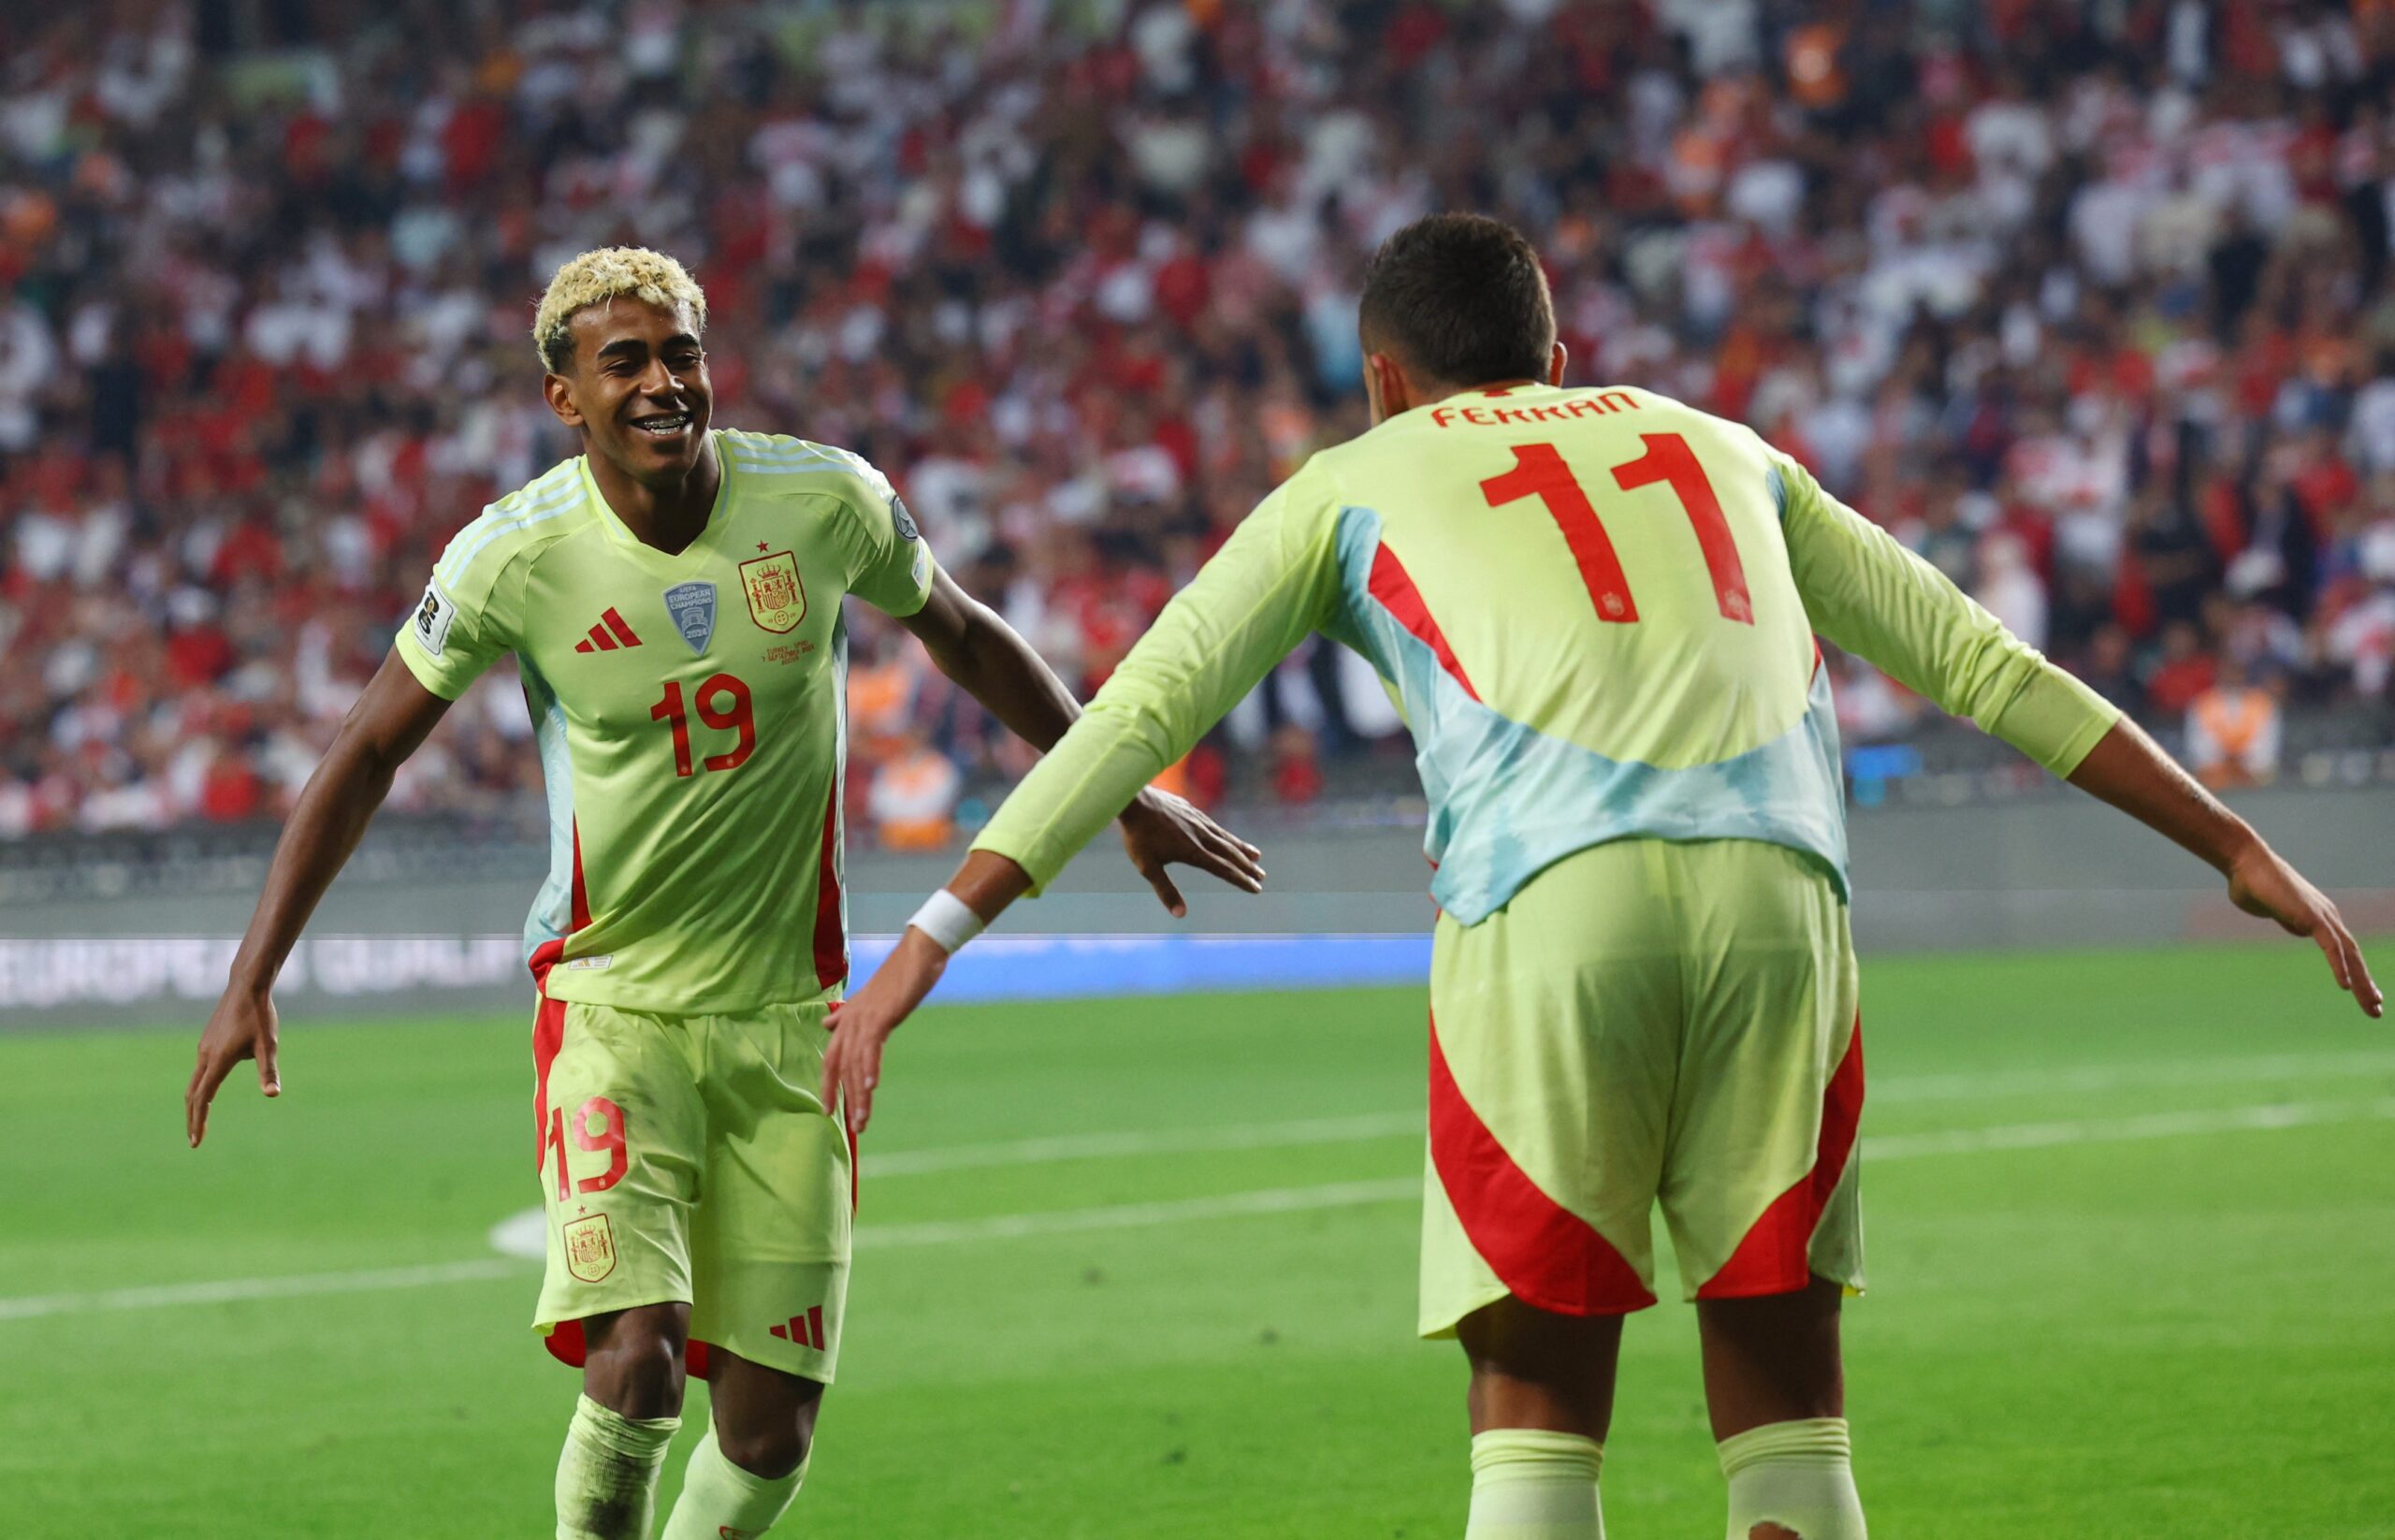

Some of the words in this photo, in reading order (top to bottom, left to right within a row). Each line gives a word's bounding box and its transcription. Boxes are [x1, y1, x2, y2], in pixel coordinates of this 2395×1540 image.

[1430, 392, 1640, 428] FERRAN
[1479, 432, 1754, 626] 11
[668, 588, 711, 603] EUROPEAN
[679, 585, 697, 594] UEFA
[670, 597, 712, 610] CHAMPIONS
[686, 628, 708, 639] 2024
[651, 674, 756, 777] 19
[548, 1096, 628, 1202] 19
